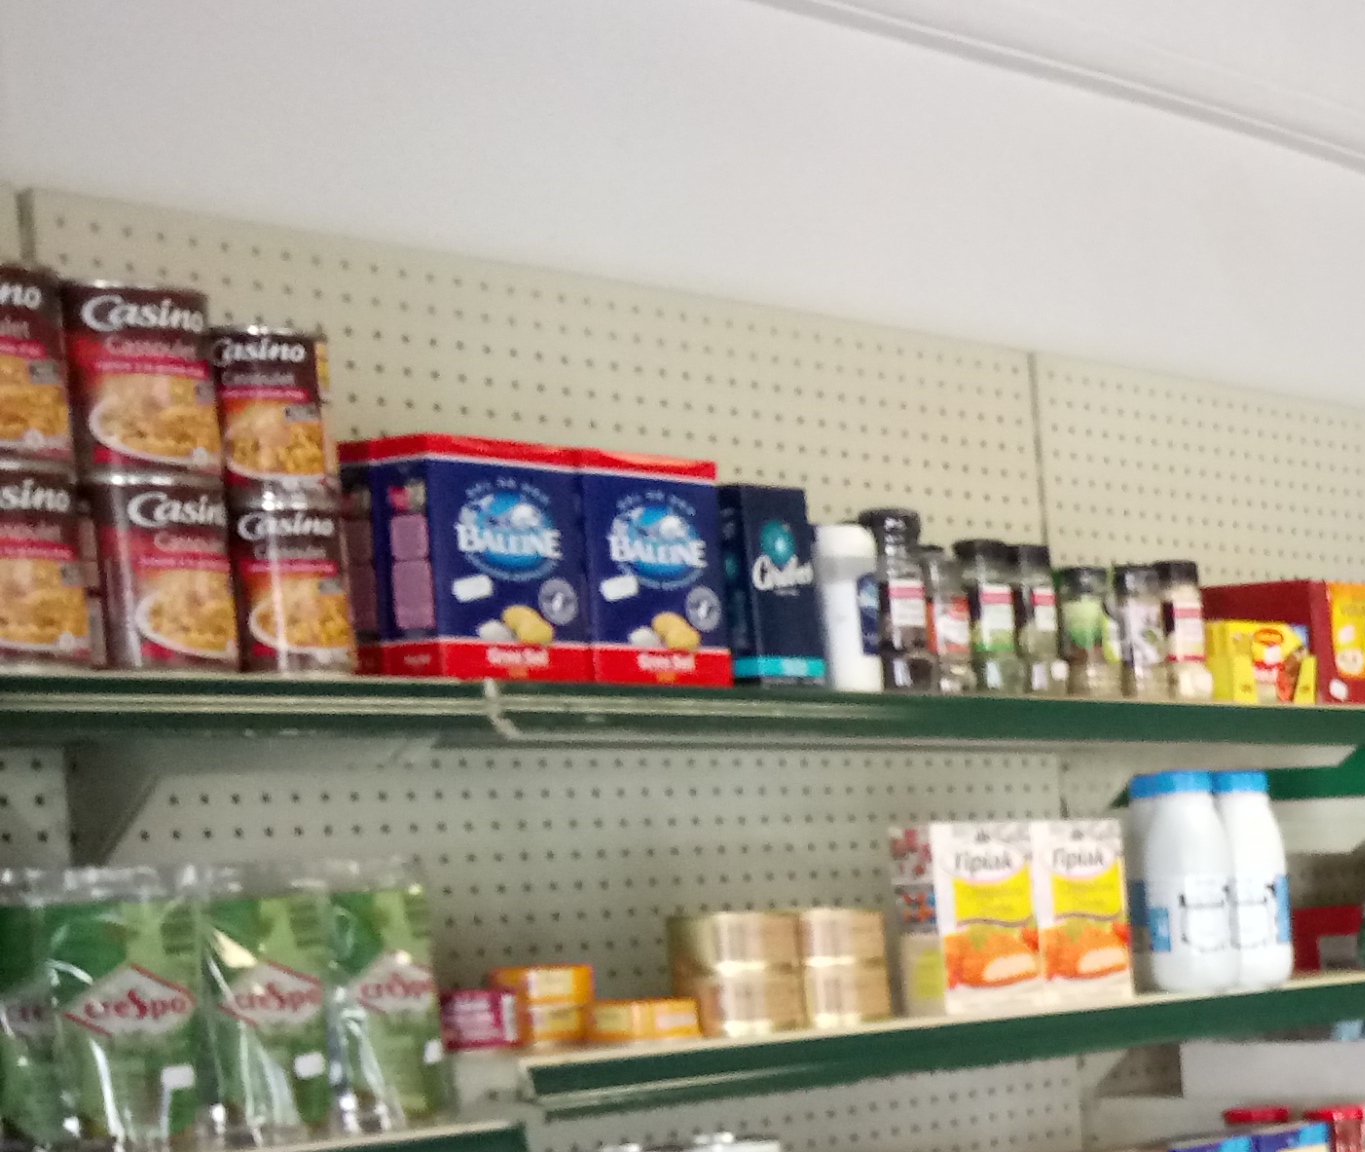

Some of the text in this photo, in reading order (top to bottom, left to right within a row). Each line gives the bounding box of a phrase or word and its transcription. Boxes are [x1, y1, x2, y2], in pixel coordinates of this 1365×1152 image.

[80, 294, 205, 332] Casino
[0, 478, 71, 513] sino
[127, 490, 228, 528] Casin
[237, 511, 336, 541] Casino
